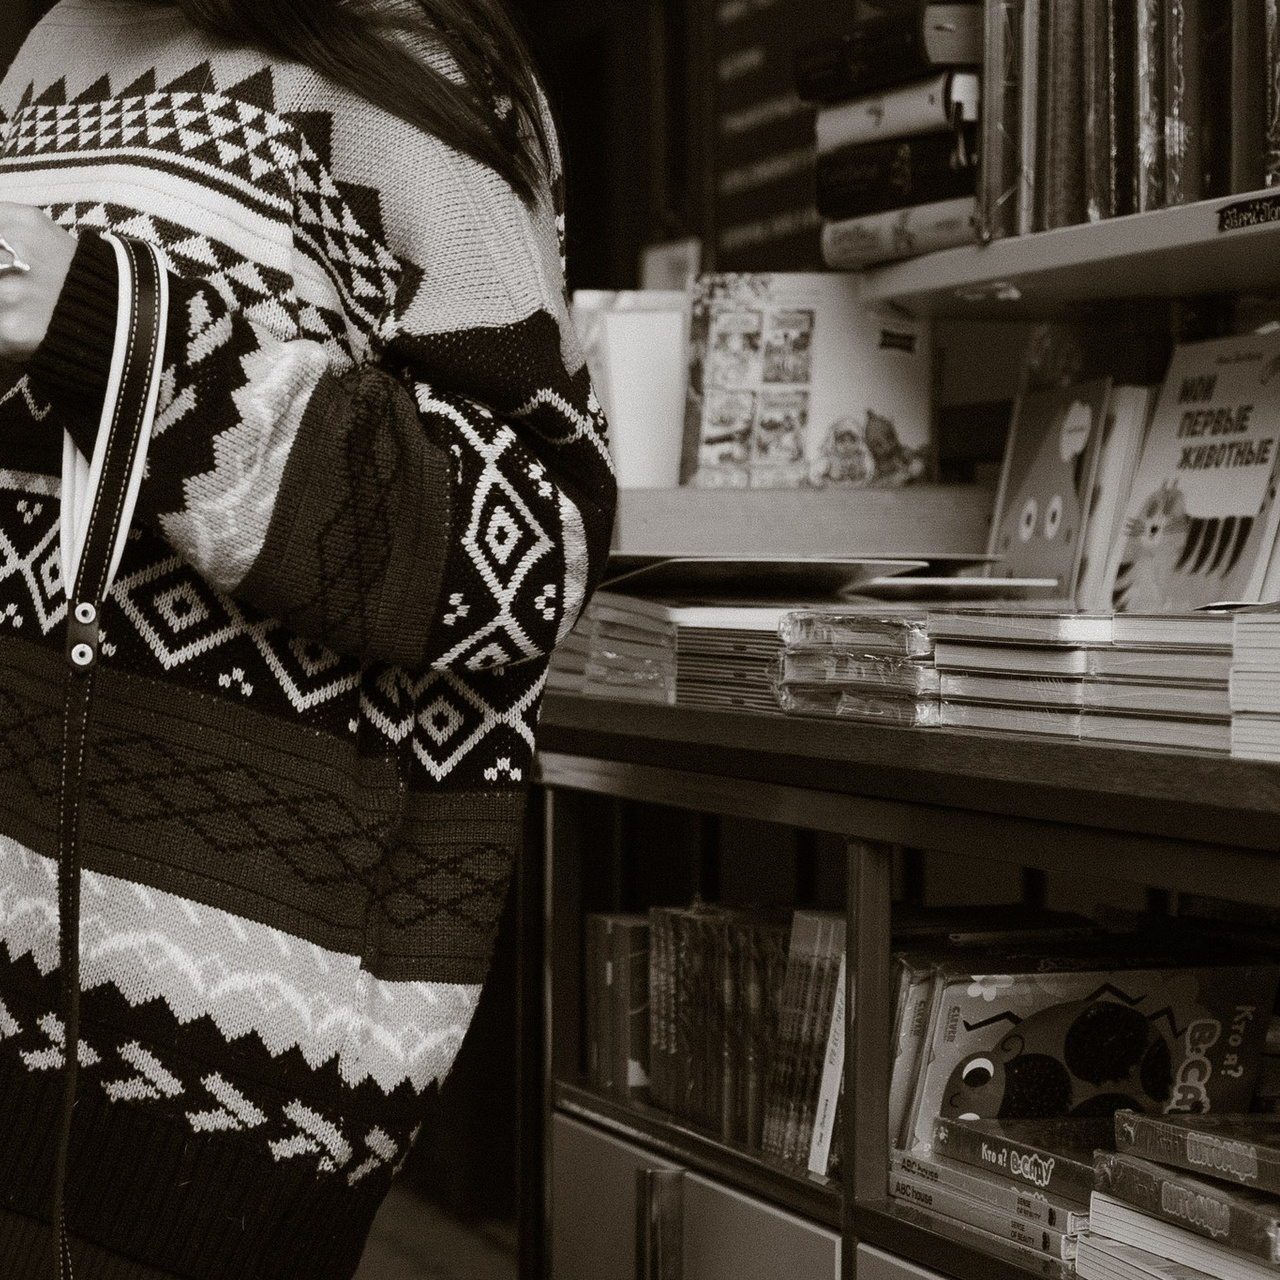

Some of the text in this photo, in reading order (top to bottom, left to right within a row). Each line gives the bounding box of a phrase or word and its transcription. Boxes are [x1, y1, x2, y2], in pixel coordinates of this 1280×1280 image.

[1177, 404, 1255, 438] ПЕРВЫЕ
[1177, 439, 1274, 470] ЖИВОТНЫЕ
[1228, 1005, 1256, 1047] Кто
[981, 1142, 996, 1163] Кто
[896, 1181, 933, 1206] ABC house
